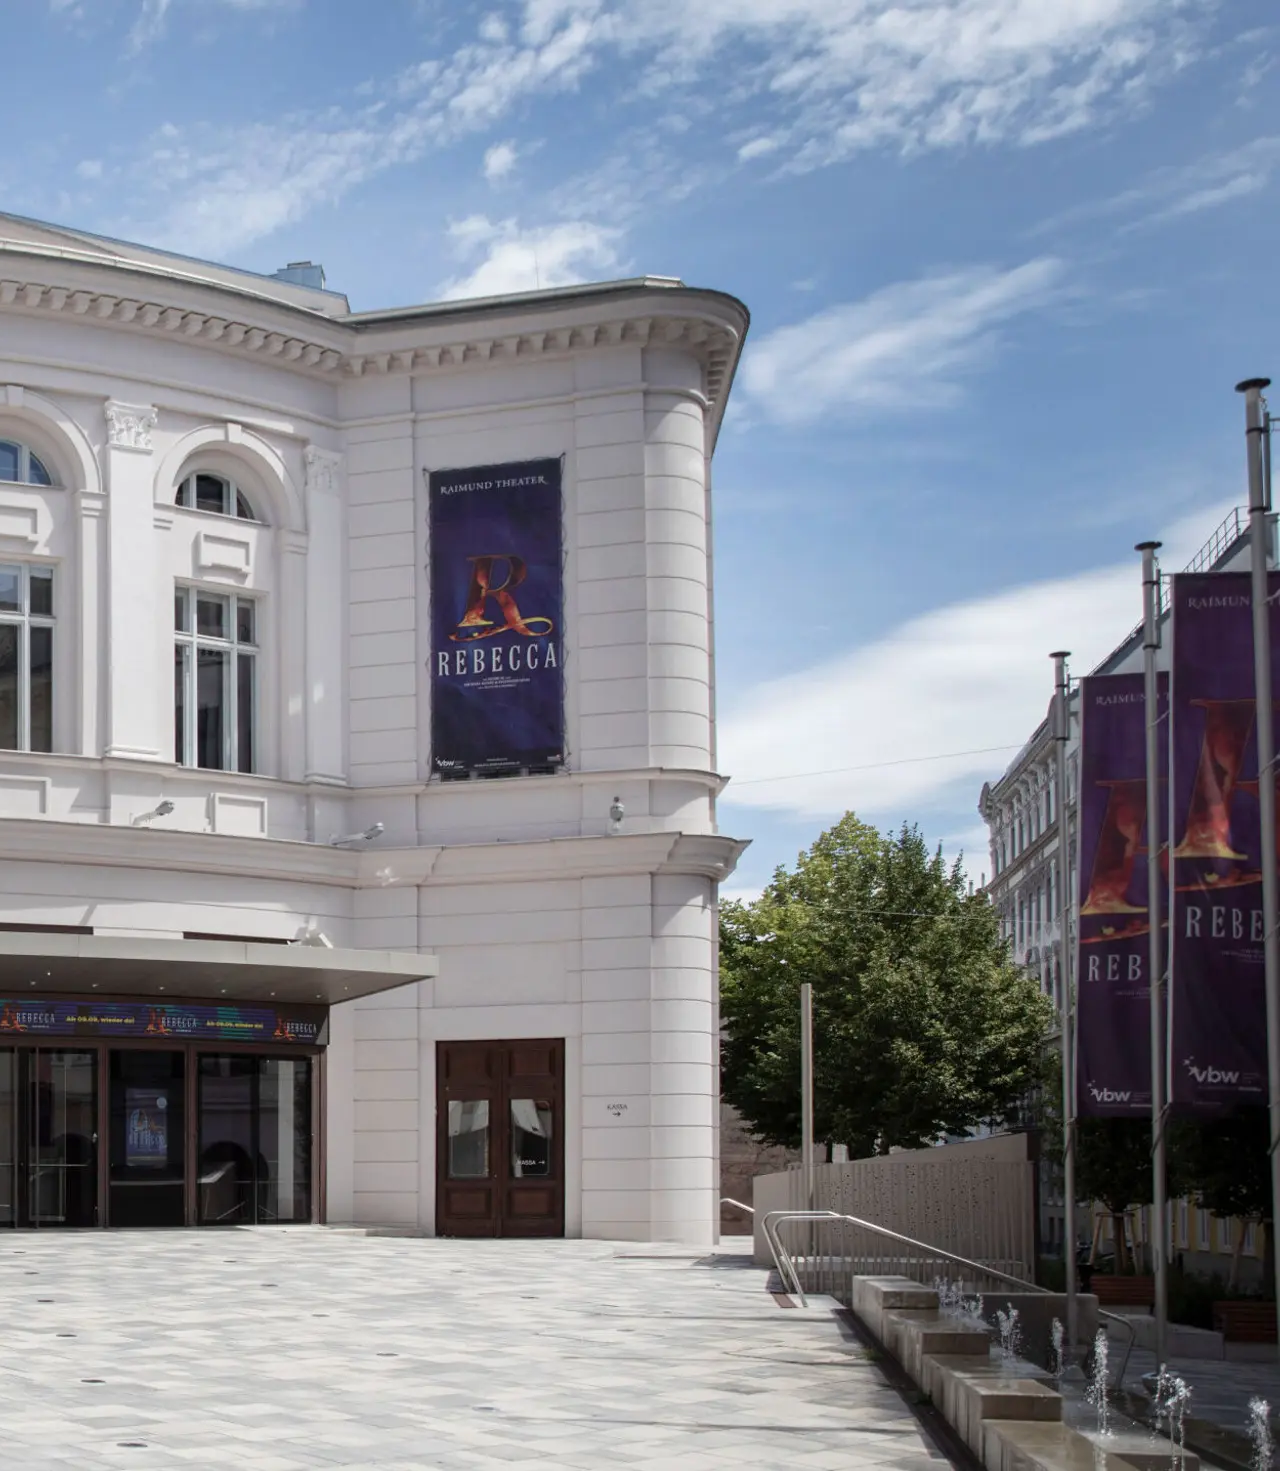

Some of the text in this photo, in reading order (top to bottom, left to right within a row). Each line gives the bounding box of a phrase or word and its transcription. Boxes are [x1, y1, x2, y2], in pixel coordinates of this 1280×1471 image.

[440, 475, 548, 495] RAIMUND THEATER
[1188, 595, 1250, 609] RAIMUN
[438, 643, 558, 677] REBECCA
[1185, 905, 1263, 942] REBE
[1085, 953, 1142, 982] REB
[16, 1012, 55, 1024] REBECCA
[161, 1016, 197, 1028] REBECCA
[286, 1022, 317, 1034] REBECCA
[1192, 1065, 1240, 1084] vbw
[1093, 1087, 1131, 1102] vbw
